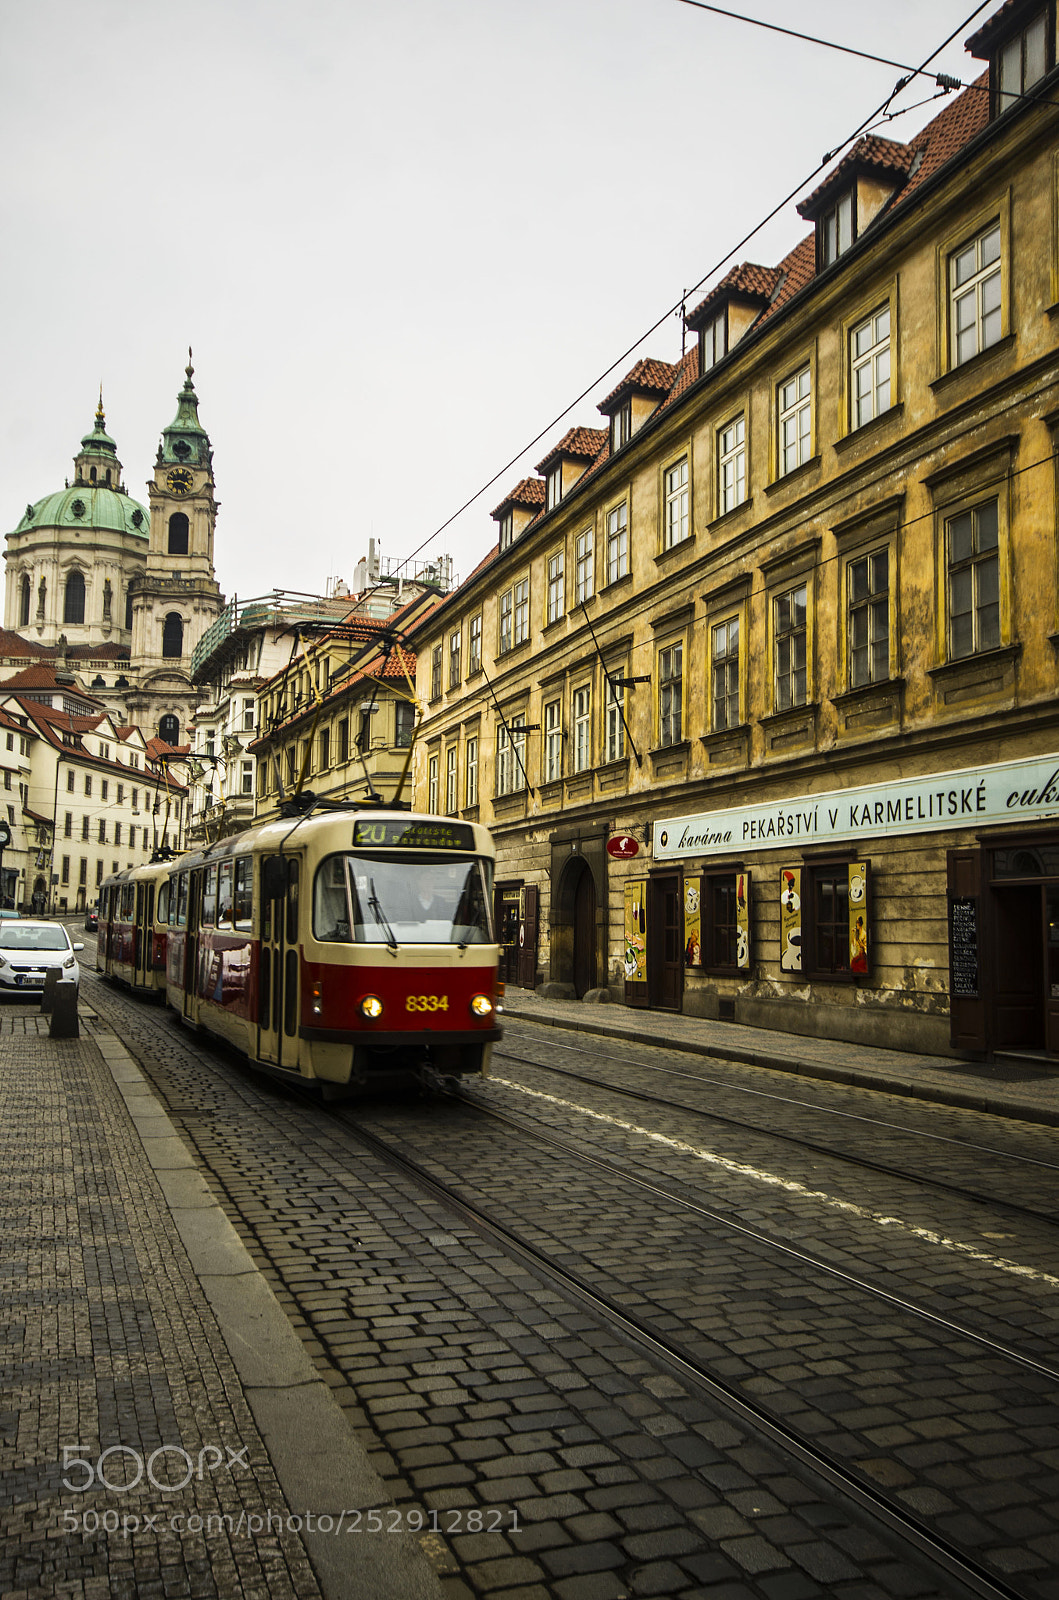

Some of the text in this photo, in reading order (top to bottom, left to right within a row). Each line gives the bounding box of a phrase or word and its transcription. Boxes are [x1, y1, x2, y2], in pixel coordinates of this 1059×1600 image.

[678, 768, 1059, 849] kavárna PEKAŘSTVÍ V KARMELITSKÉ cuk
[356, 823, 387, 843] 20
[405, 995, 449, 1012] 8334
